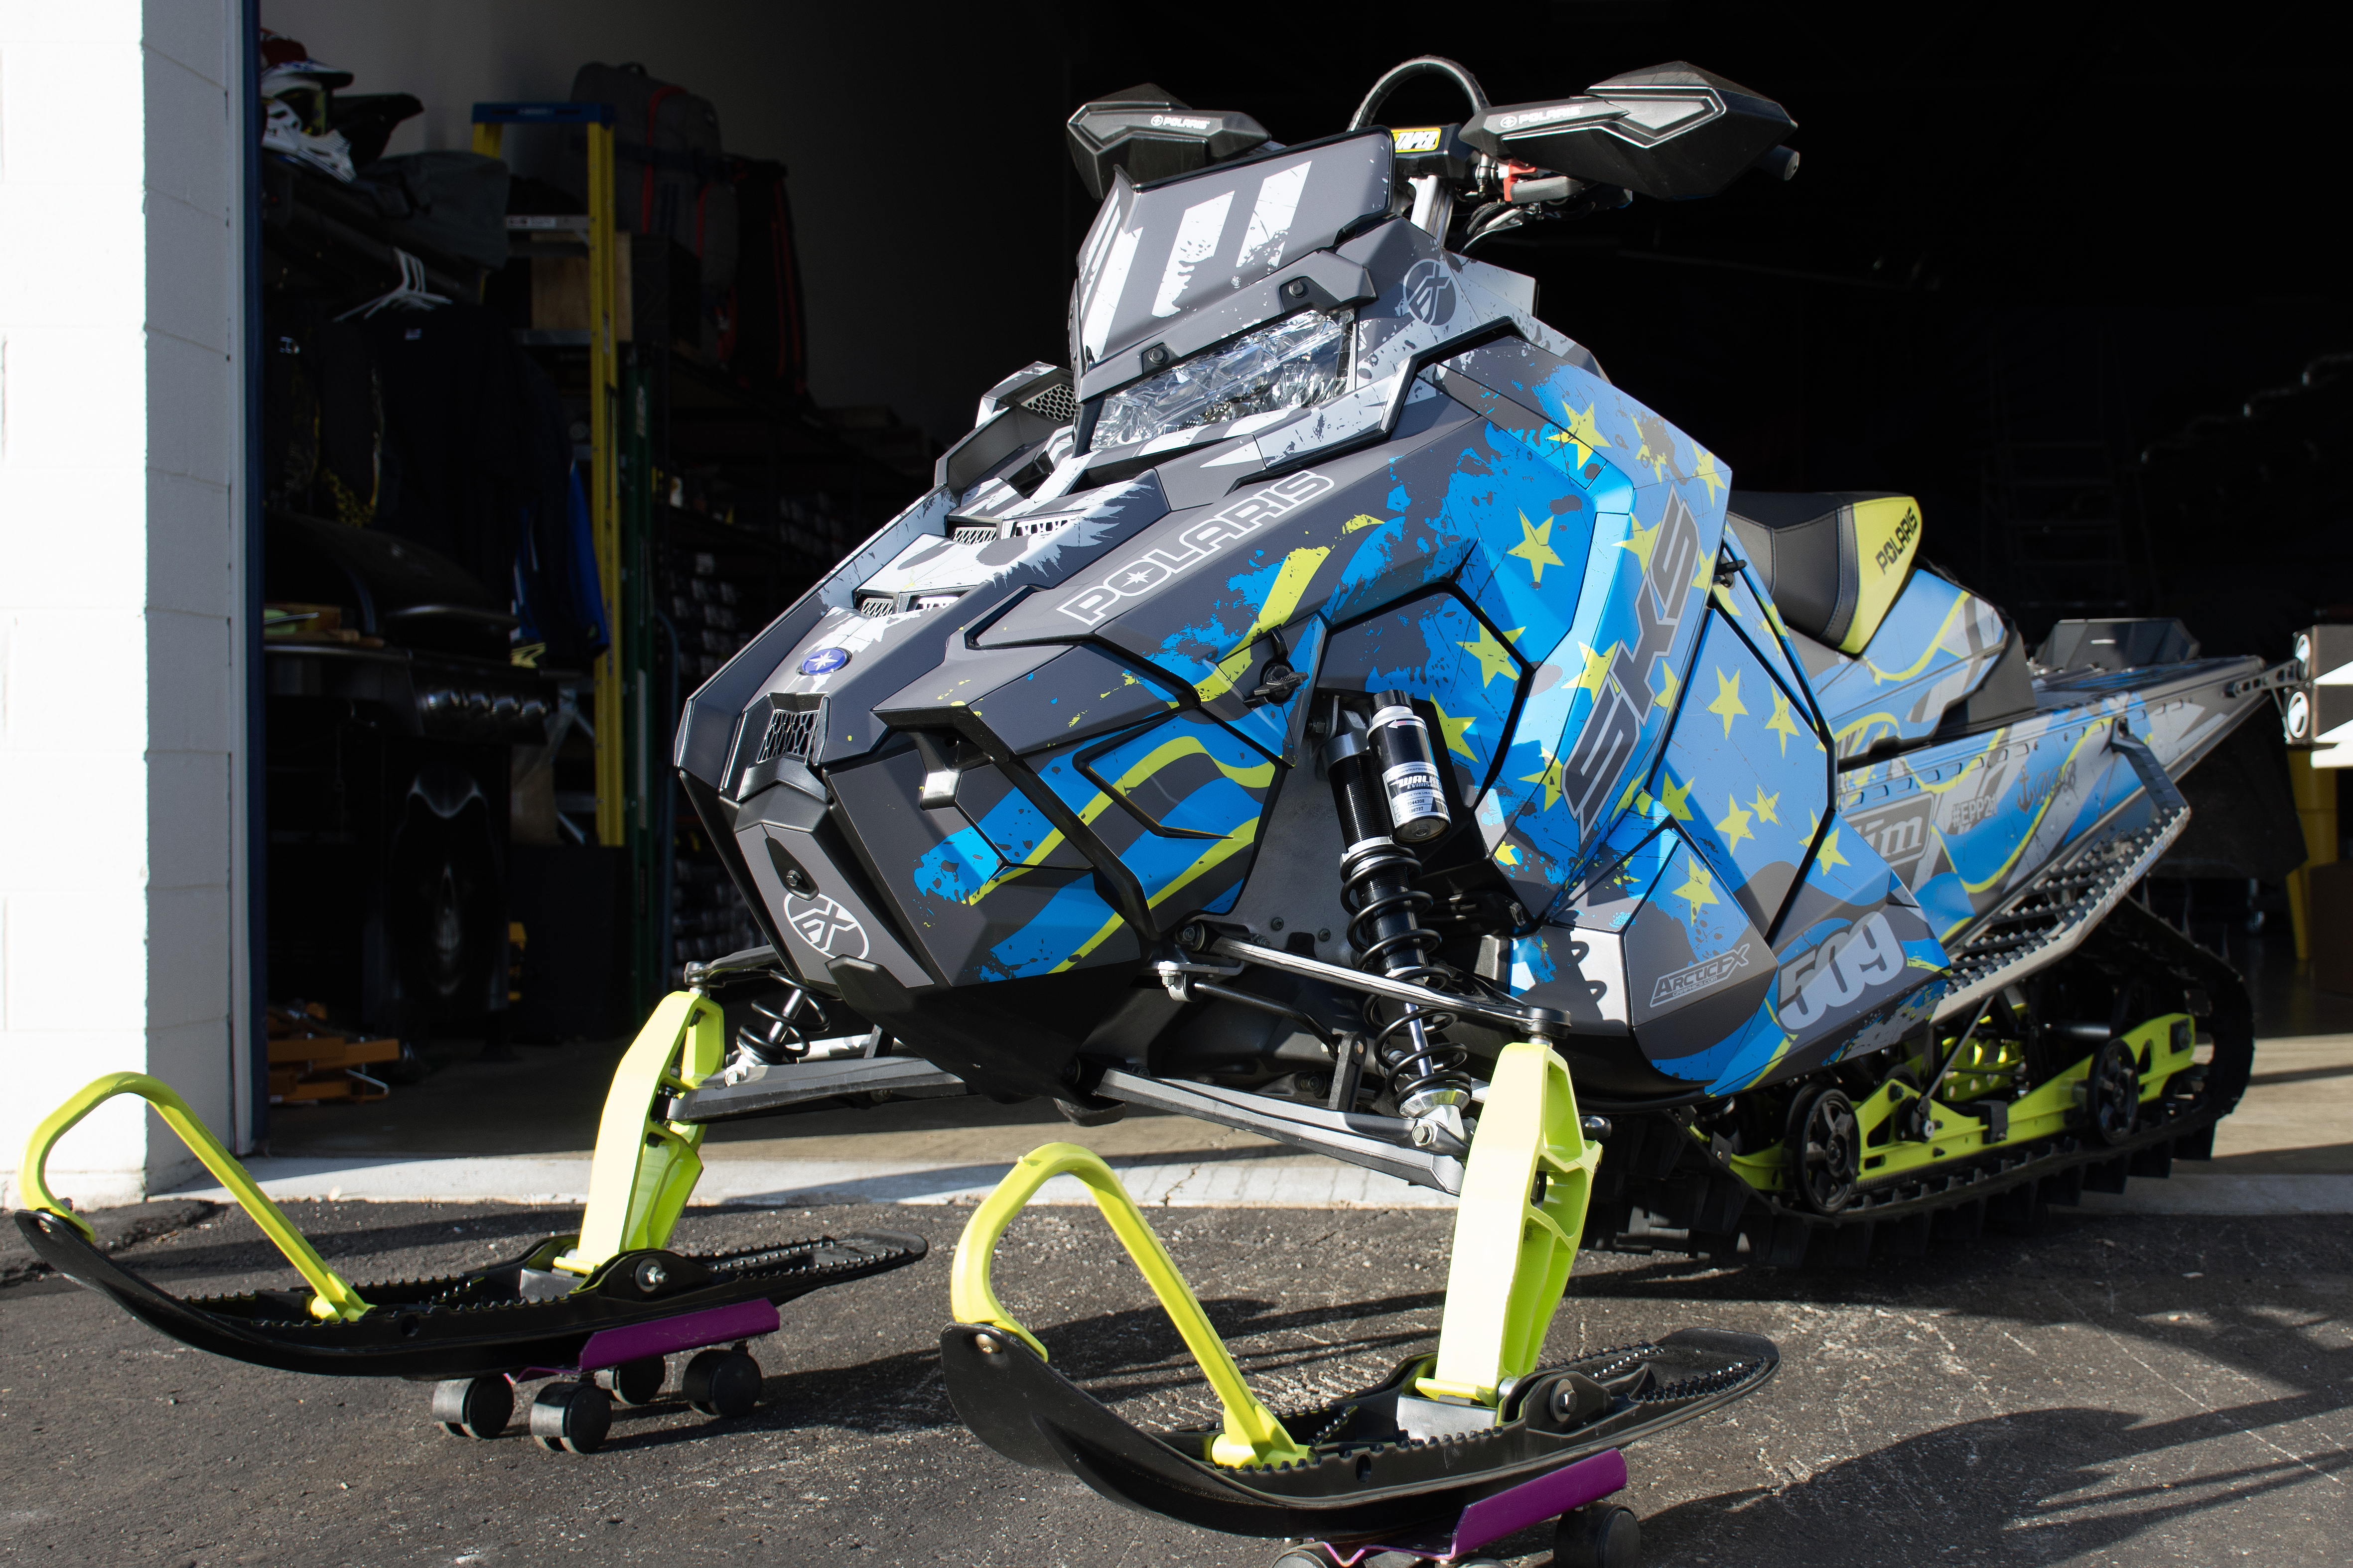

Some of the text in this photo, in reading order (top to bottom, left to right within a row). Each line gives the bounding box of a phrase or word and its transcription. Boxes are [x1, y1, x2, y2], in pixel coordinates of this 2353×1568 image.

[1163, 117, 1208, 130] POLARIS
[1519, 105, 1581, 125] POLARIS
[1056, 470, 1335, 626] POLARIS
[1875, 506, 1918, 576] POLARIS
[1560, 481, 1701, 845] SKS
[1778, 911, 1905, 1030] 509
